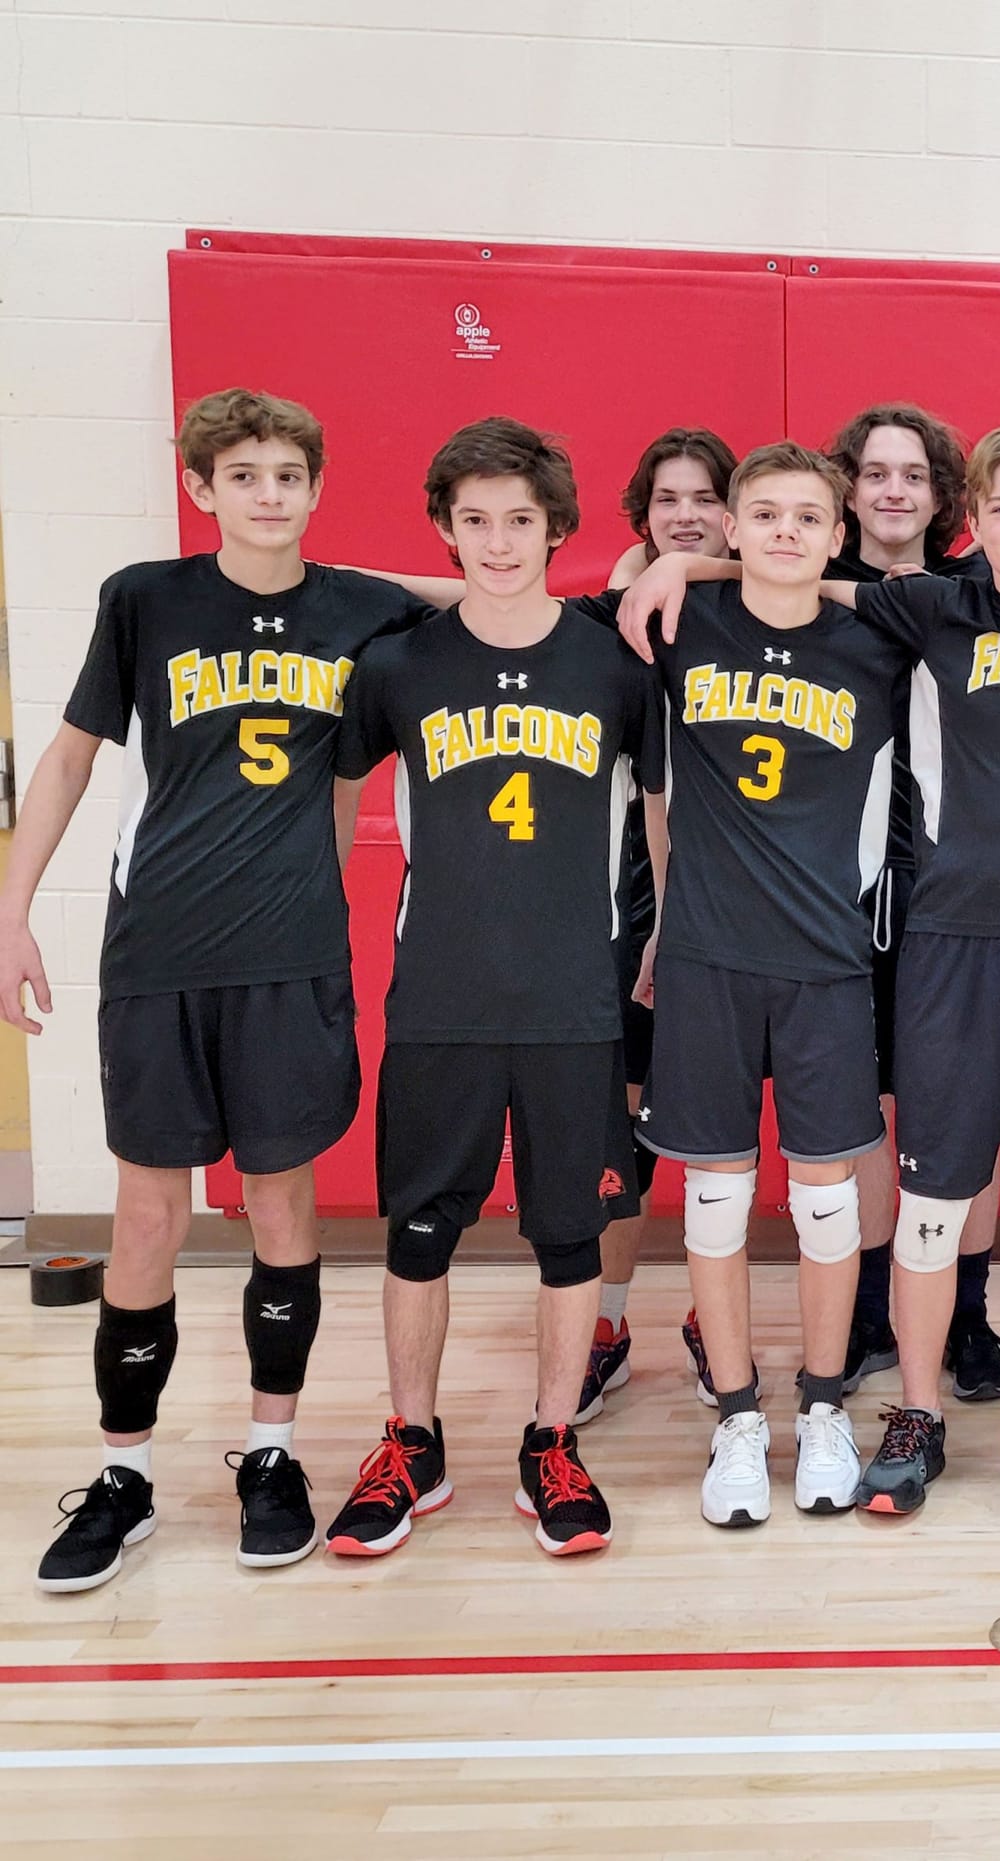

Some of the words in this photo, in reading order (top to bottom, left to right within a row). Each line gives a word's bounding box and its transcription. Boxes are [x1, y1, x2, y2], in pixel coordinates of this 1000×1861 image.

[456, 325, 490, 338] apple
[682, 663, 857, 752] FALCONS
[239, 718, 290, 785] 5
[420, 704, 602, 783] FALCONS
[738, 734, 785, 801] 3
[488, 772, 534, 840] 4
